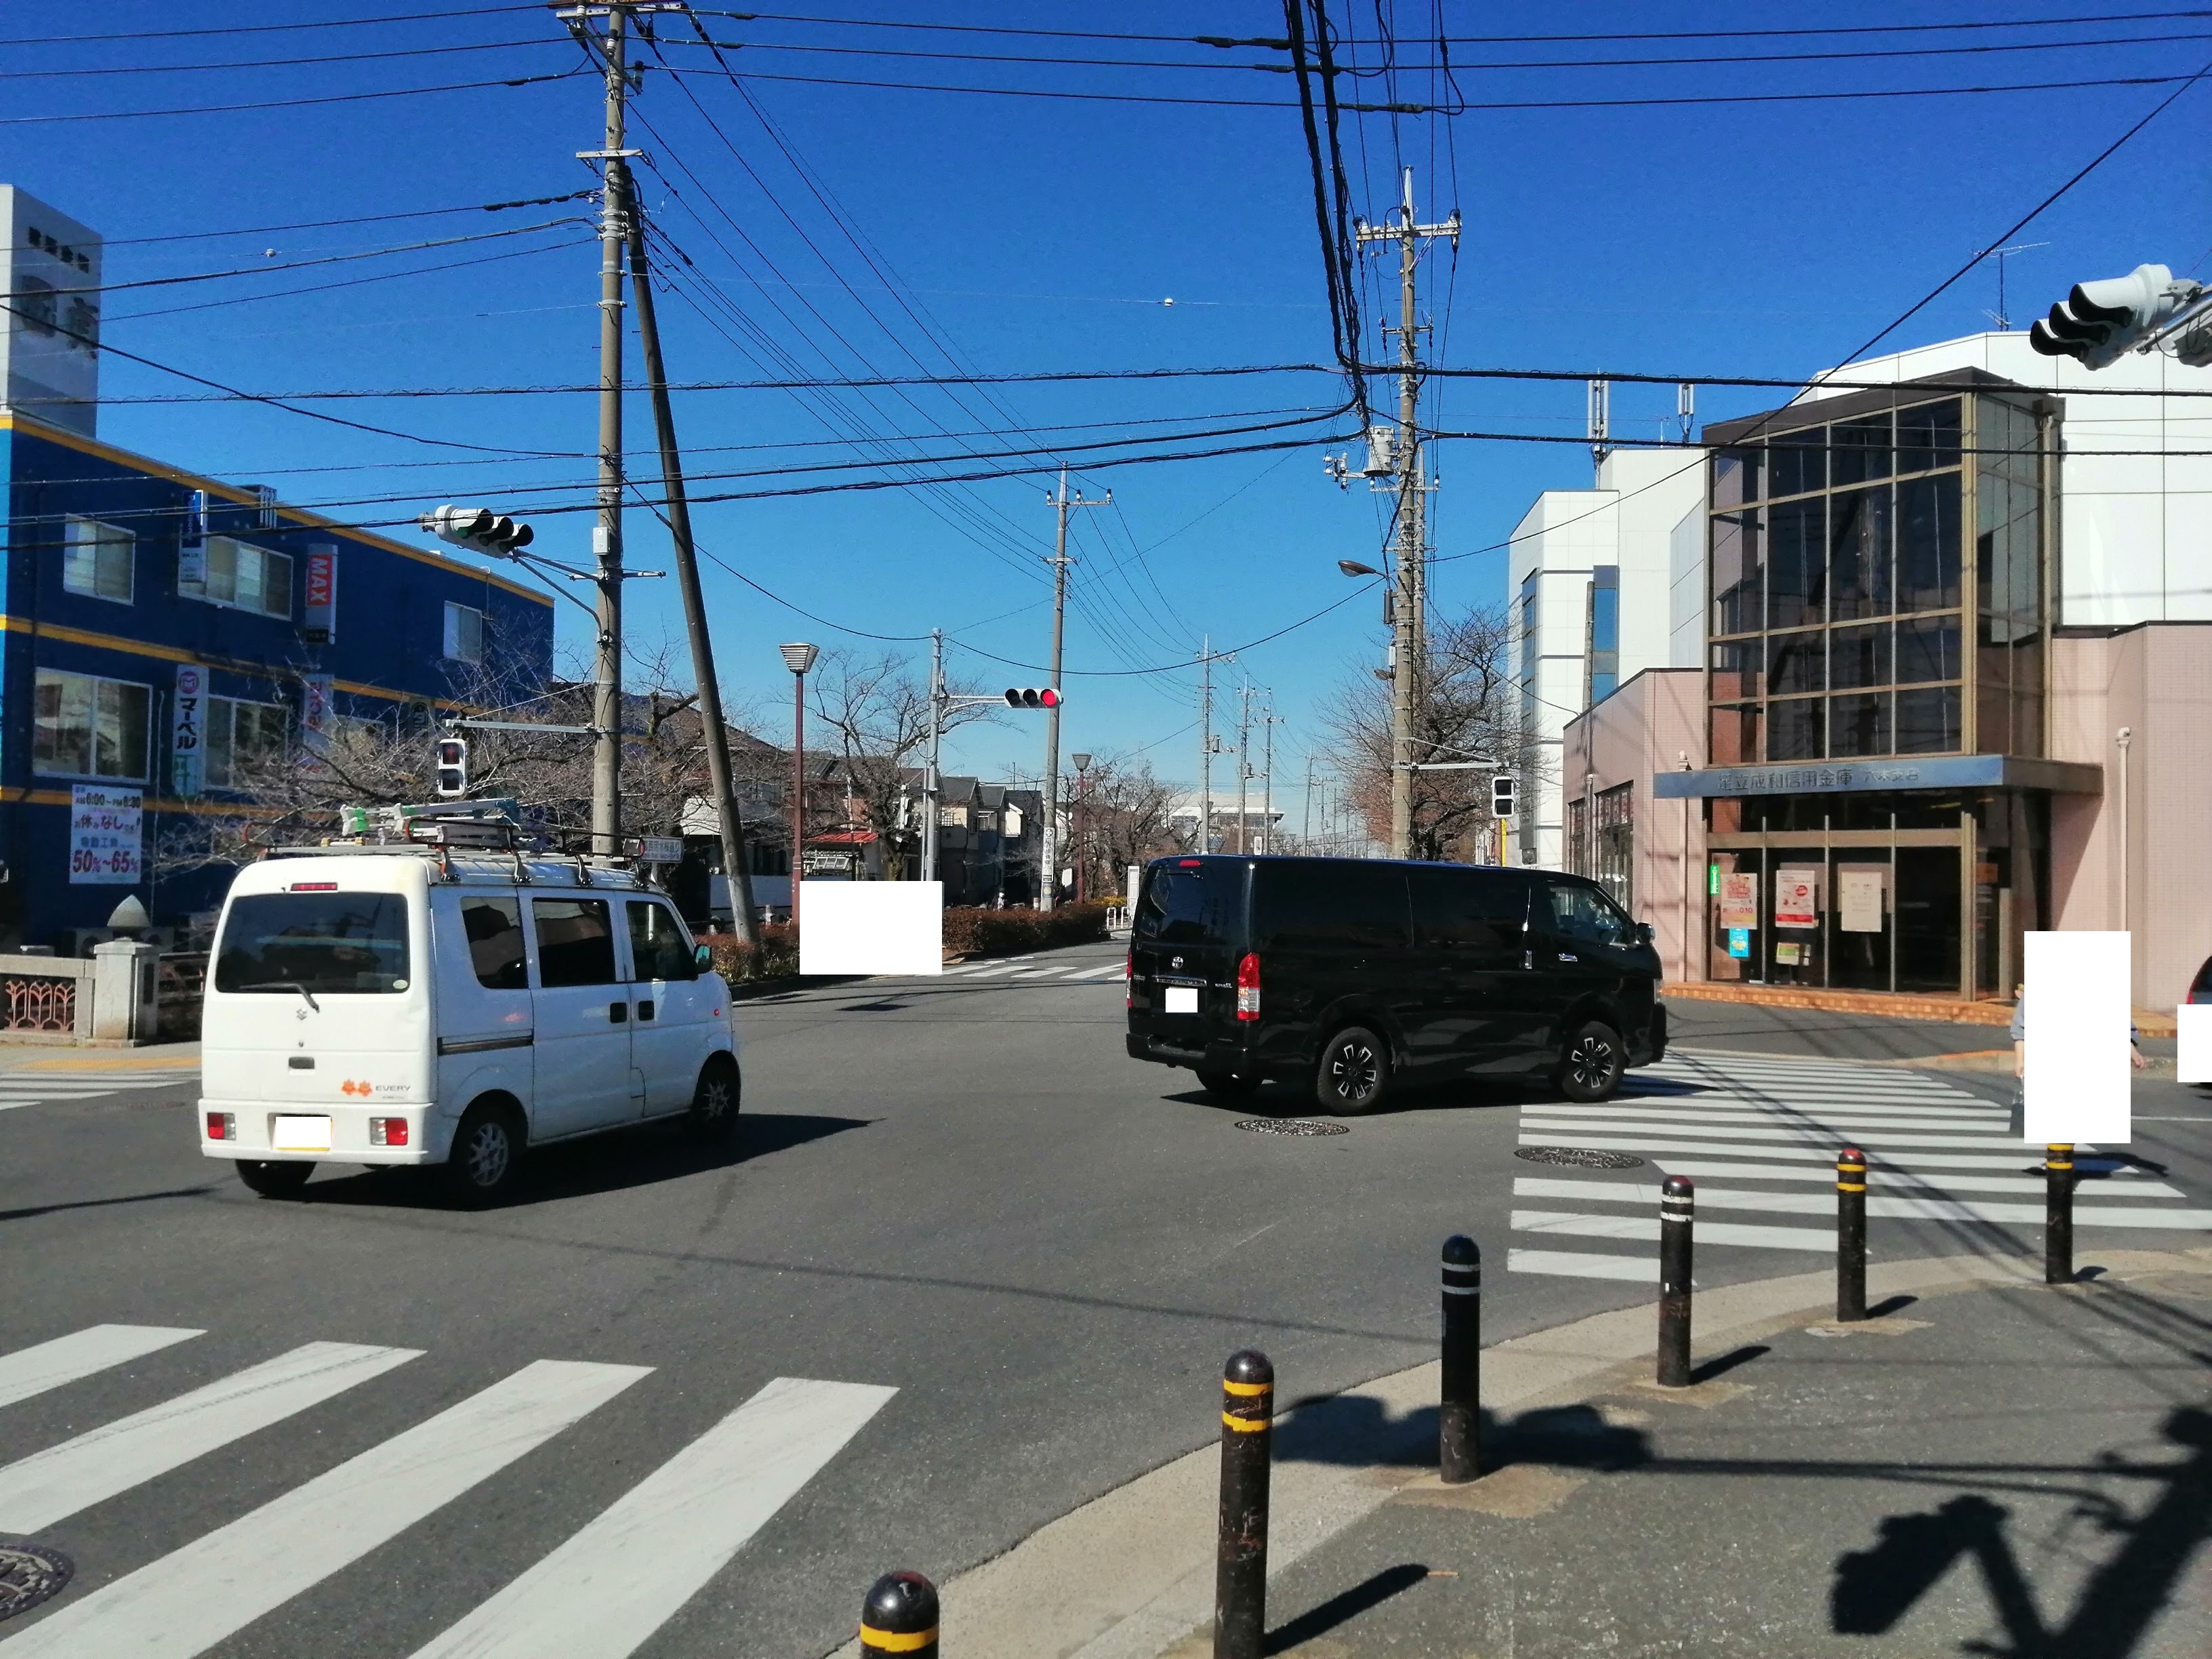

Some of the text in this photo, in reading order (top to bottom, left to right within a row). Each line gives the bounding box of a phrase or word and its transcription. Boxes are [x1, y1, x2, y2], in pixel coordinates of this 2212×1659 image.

[310, 558, 328, 602] MAX
[177, 697, 198, 750] マーベル
[1718, 769, 1852, 791] 足立成和信用金庫
